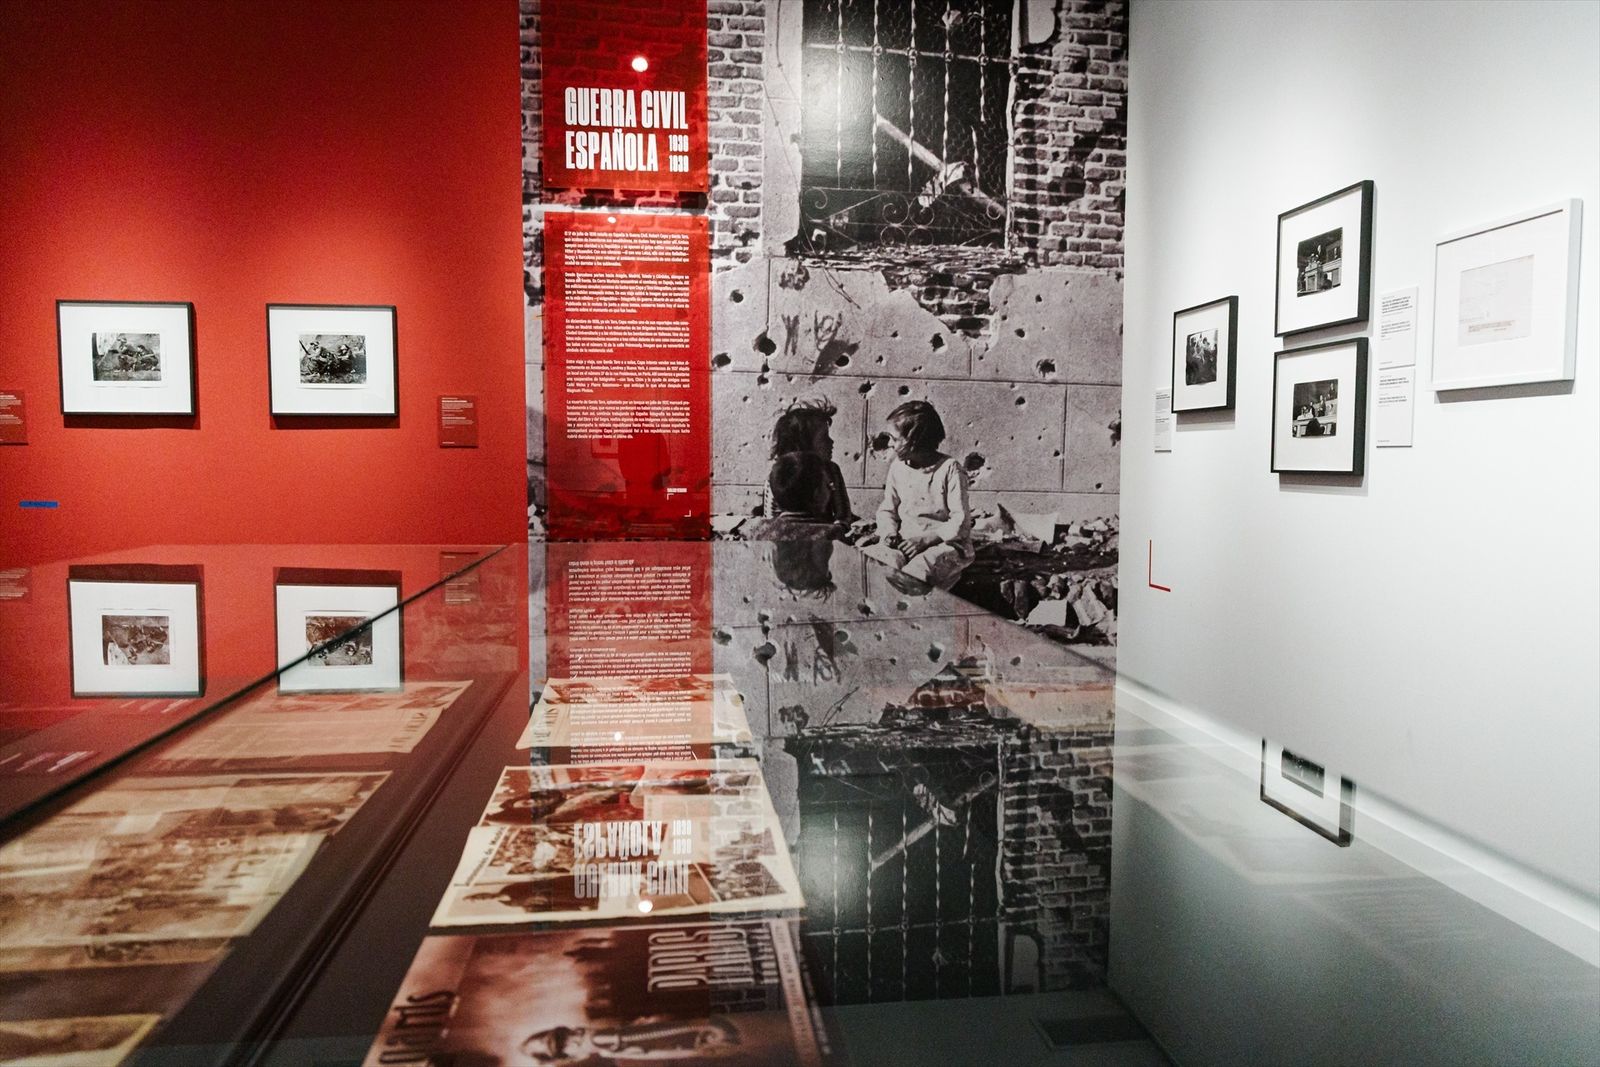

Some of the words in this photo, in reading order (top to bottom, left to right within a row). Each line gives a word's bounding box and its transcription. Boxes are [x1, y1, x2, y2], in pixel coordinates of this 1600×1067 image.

[564, 87, 637, 128] GUERRA
[641, 89, 689, 130] CIVIL
[565, 128, 659, 172] ESPAÑOLA
